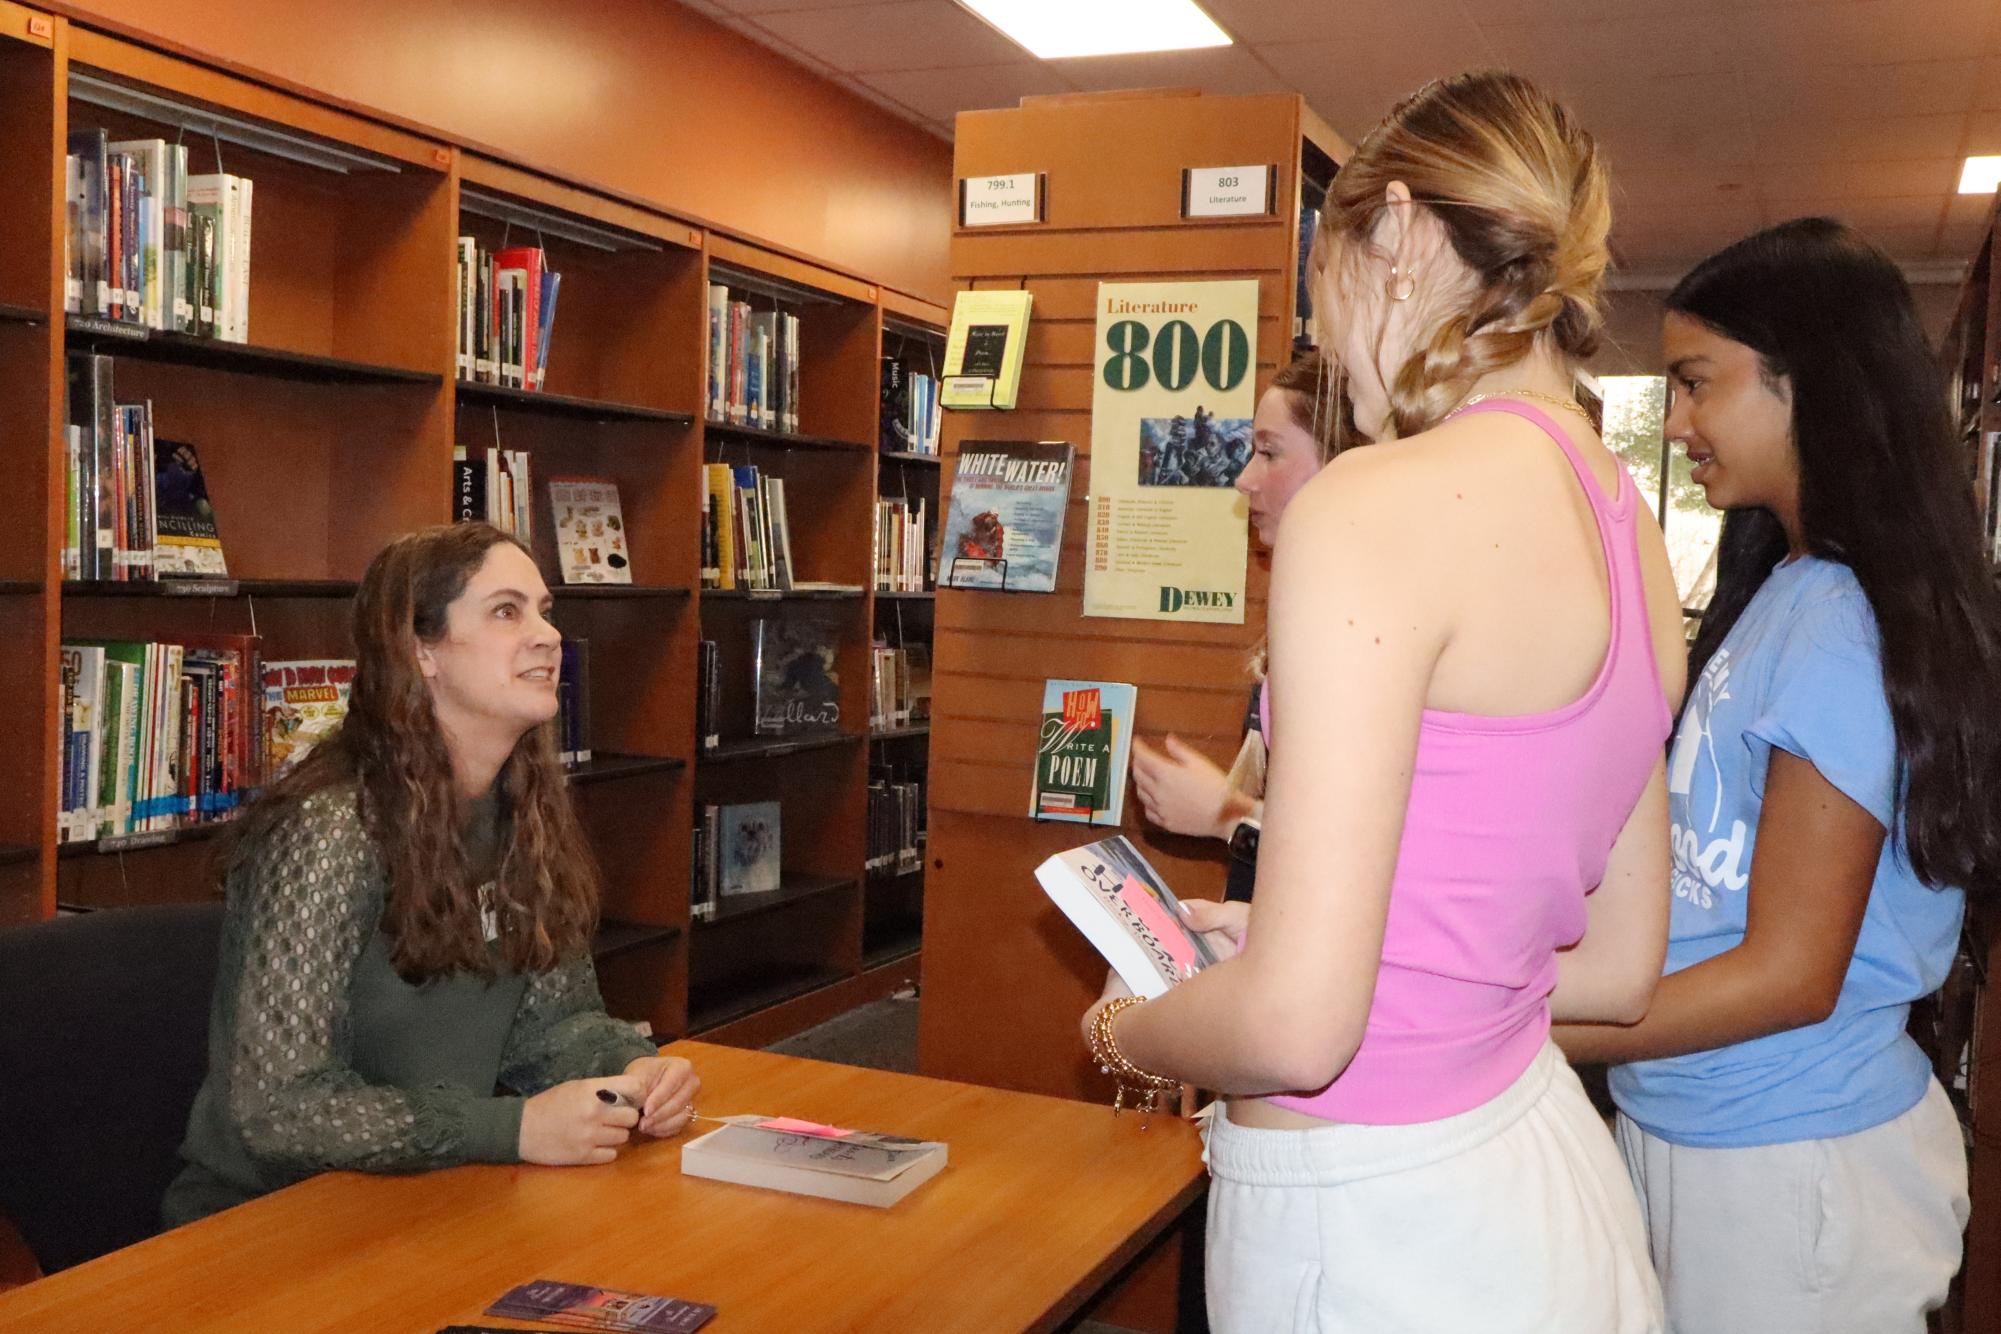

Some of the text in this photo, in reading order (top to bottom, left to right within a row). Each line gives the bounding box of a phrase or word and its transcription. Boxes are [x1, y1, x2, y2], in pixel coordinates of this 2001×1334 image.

[987, 178, 1015, 190] 799.1
[1218, 176, 1239, 188] 803
[970, 198, 1031, 209] Fishing, Hunting
[1209, 194, 1247, 204] Literature
[1106, 298, 1198, 314] Literature
[92, 321, 145, 338] Architecture
[1103, 319, 1249, 392] 800
[891, 362, 900, 389] Music
[463, 466, 473, 492] Arts
[462, 495, 473, 505] &
[159, 520, 215, 532] NCILLING
[1158, 586, 1238, 613] DEWEY
[286, 687, 337, 701] MARVEL
[1066, 690, 1099, 719] HOW
[1039, 717, 1110, 754] WRITE A
[127, 735, 137, 766] BOOK
[1048, 755, 1098, 788] POEM
